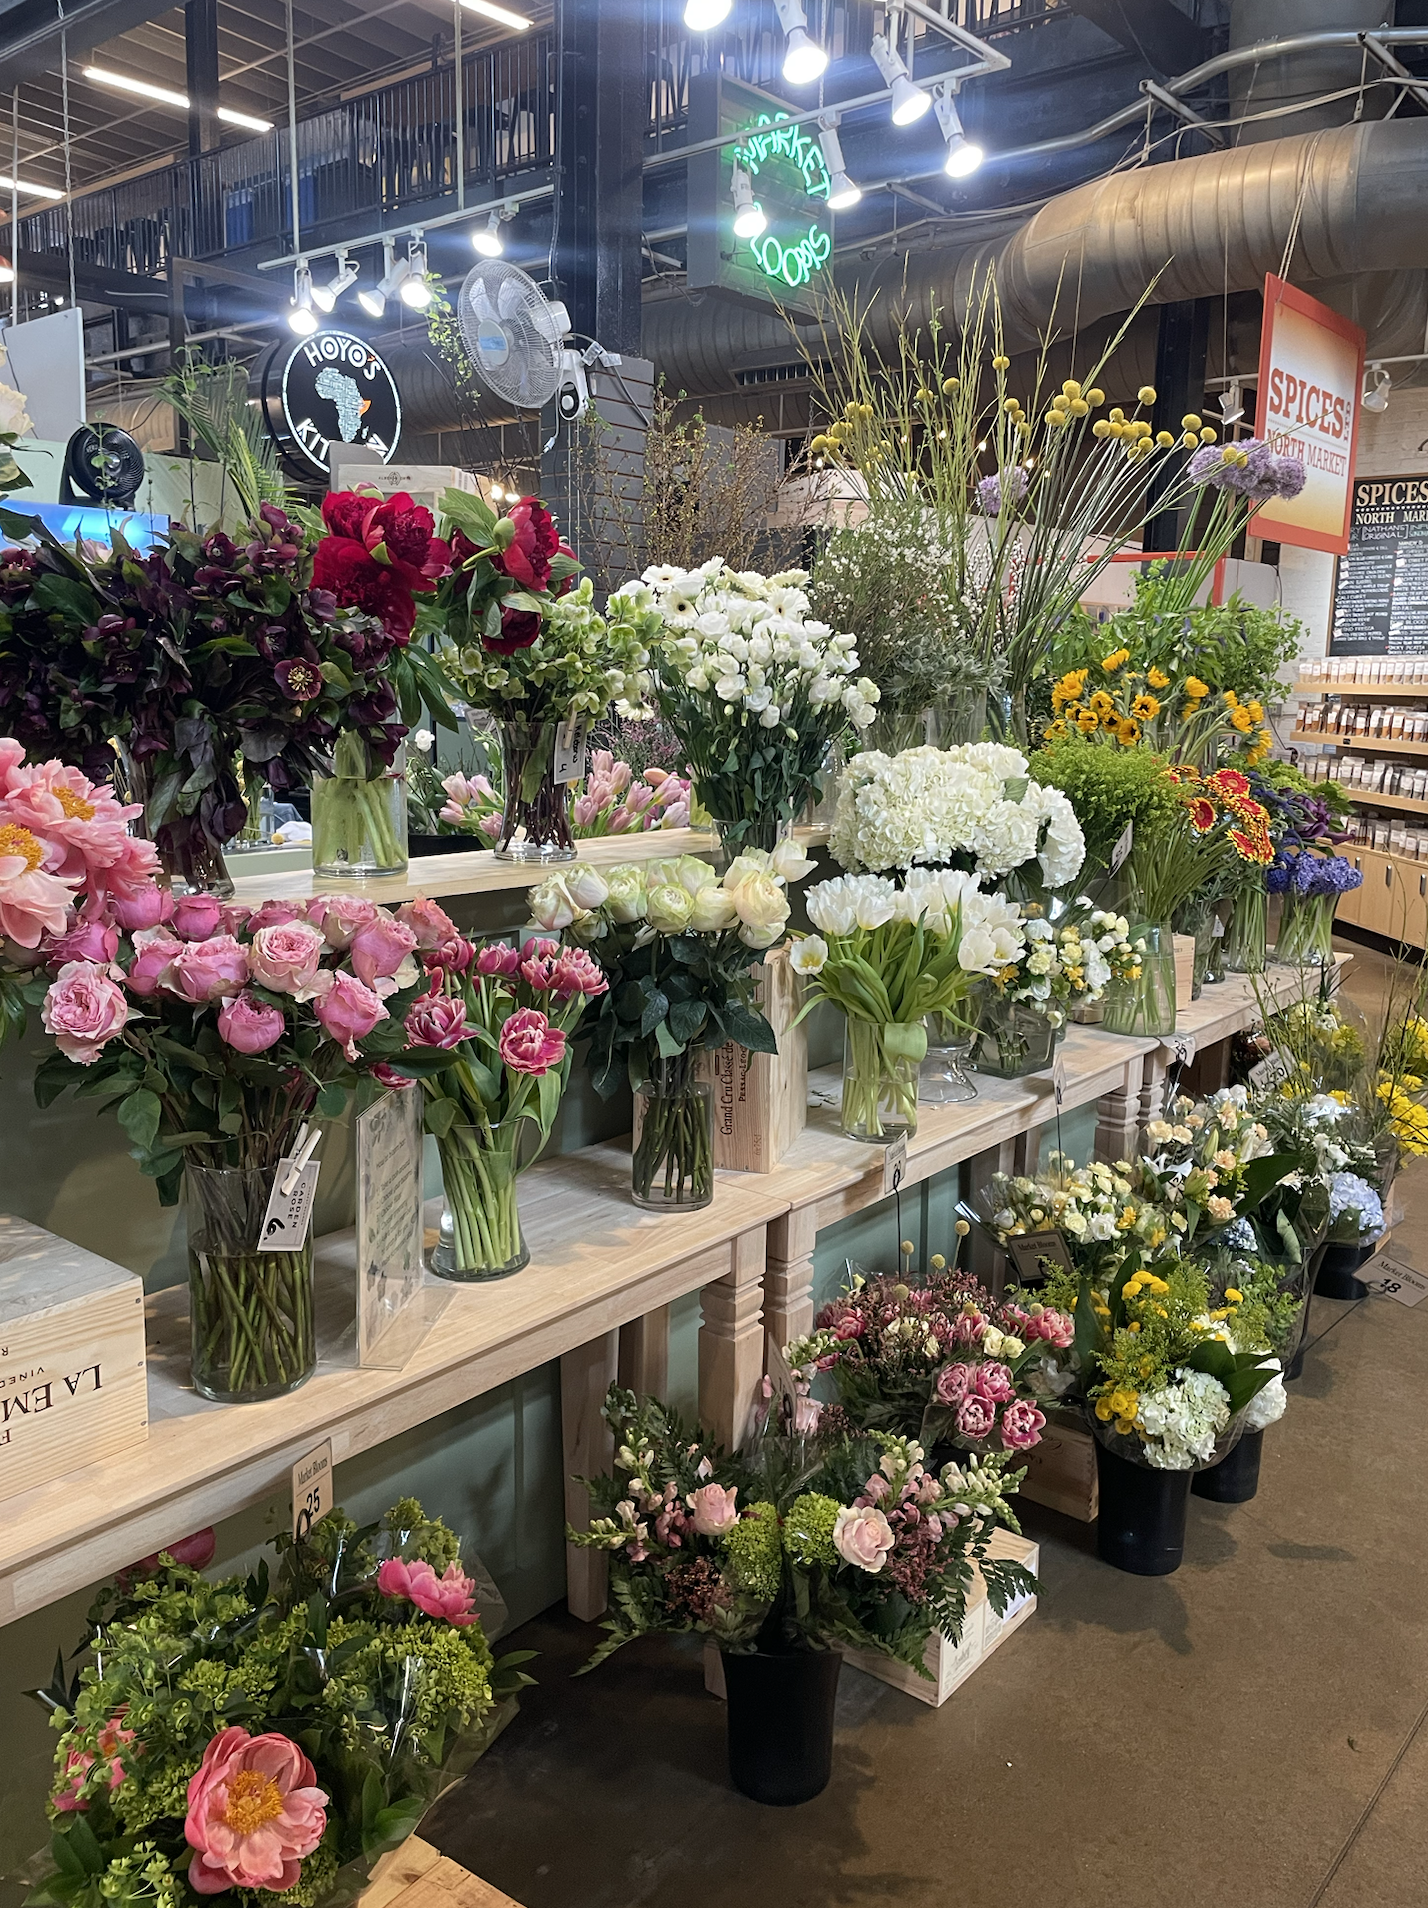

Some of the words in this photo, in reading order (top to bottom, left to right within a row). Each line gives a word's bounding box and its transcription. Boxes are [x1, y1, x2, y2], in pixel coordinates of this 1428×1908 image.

[750, 201, 831, 288] LOOMS
[303, 336, 381, 381] HOYO'S
[1269, 367, 1345, 439] SPICES
[1267, 428, 1305, 459] NORTH
[1307, 443, 1347, 477] MARKET
[1356, 481, 1428, 507] SPICES
[1355, 511, 1395, 525] NORTH
[1403, 509, 1428, 523] MAR
[721, 1041, 734, 1053] de
[720, 1053, 734, 1085] Classé
[720, 1085, 733, 1104] Cru
[720, 1104, 733, 1135] Grand
[286, 1190, 299, 1220] ROSE
[291, 1182, 307, 1229] GARDEN
[1378, 1261, 1403, 1278] Market
[1402, 1273, 1426, 1291] Blooms
[62, 1363, 103, 1396] LA
[306, 1486, 321, 1518] 25
